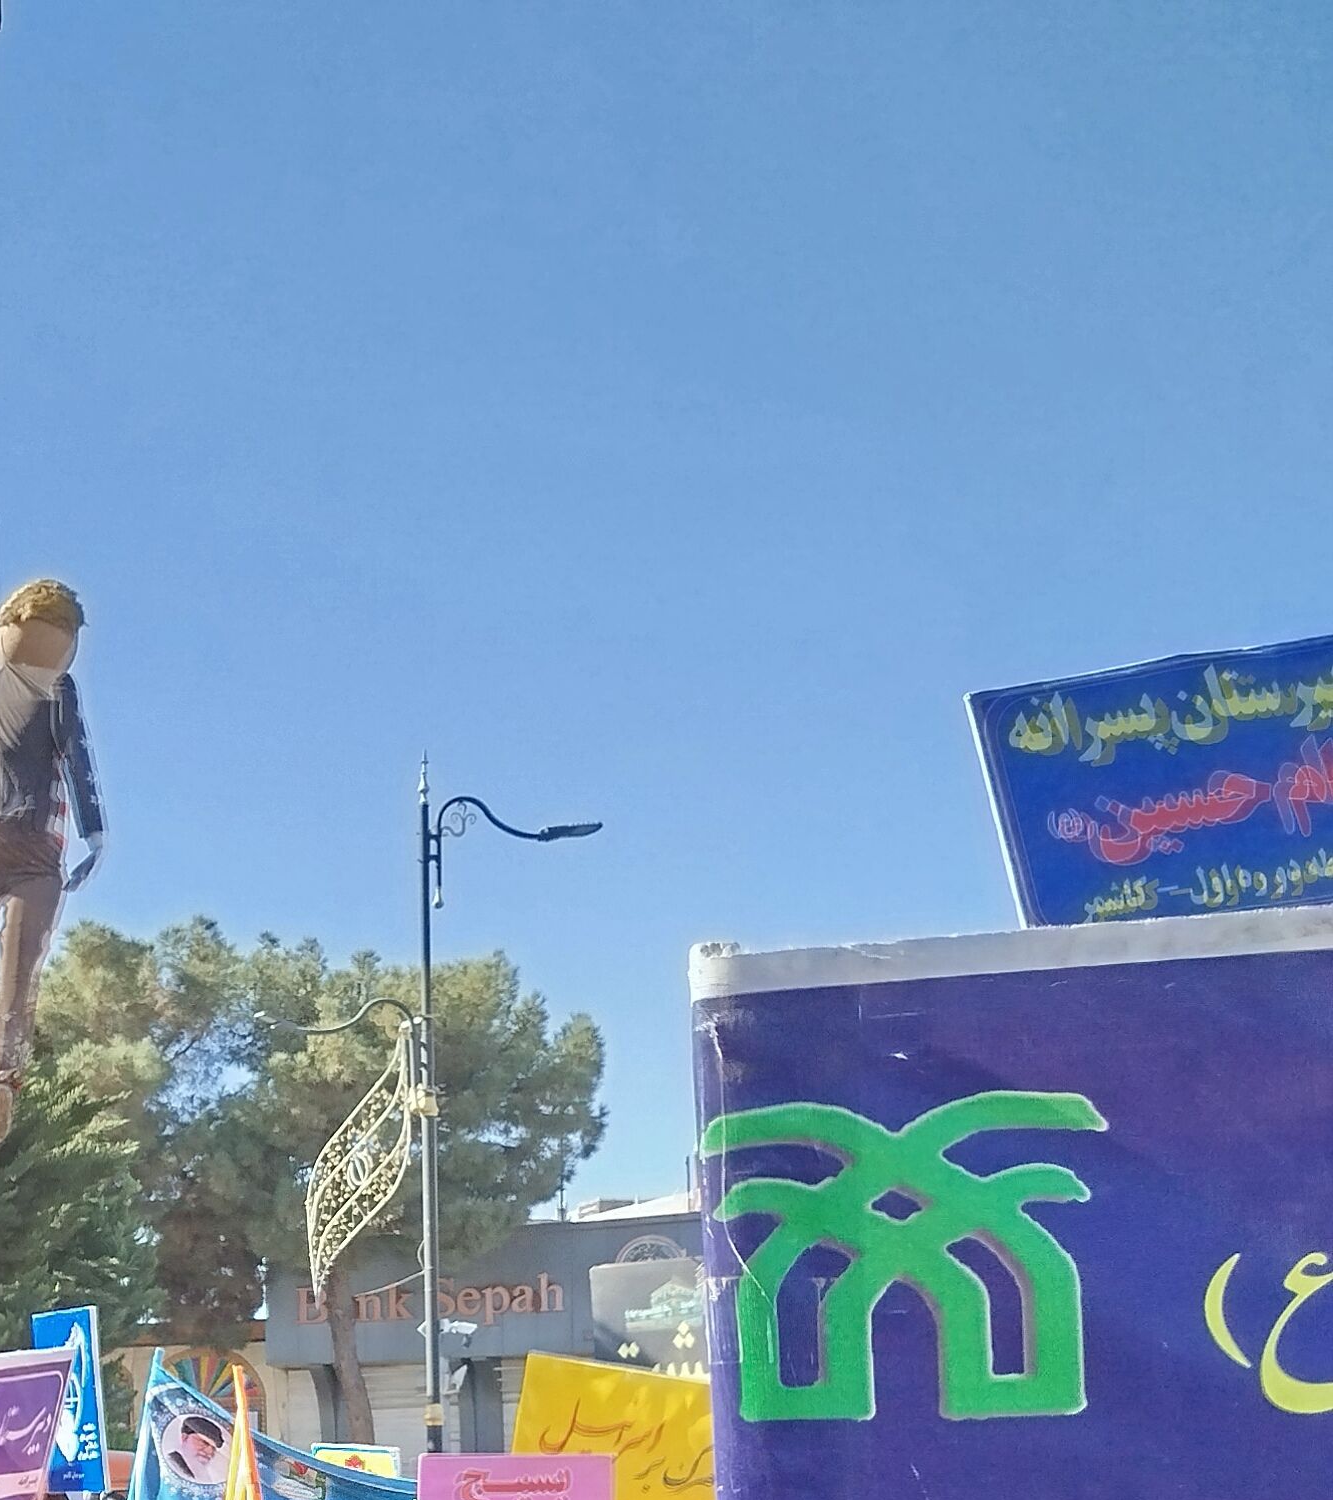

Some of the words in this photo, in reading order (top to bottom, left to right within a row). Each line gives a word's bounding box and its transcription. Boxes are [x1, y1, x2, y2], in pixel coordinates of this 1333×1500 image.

[1008, 690, 1179, 767] پسرانه
[1088, 769, 1272, 866] حسین
[295, 1286, 414, 1325] Bnk
